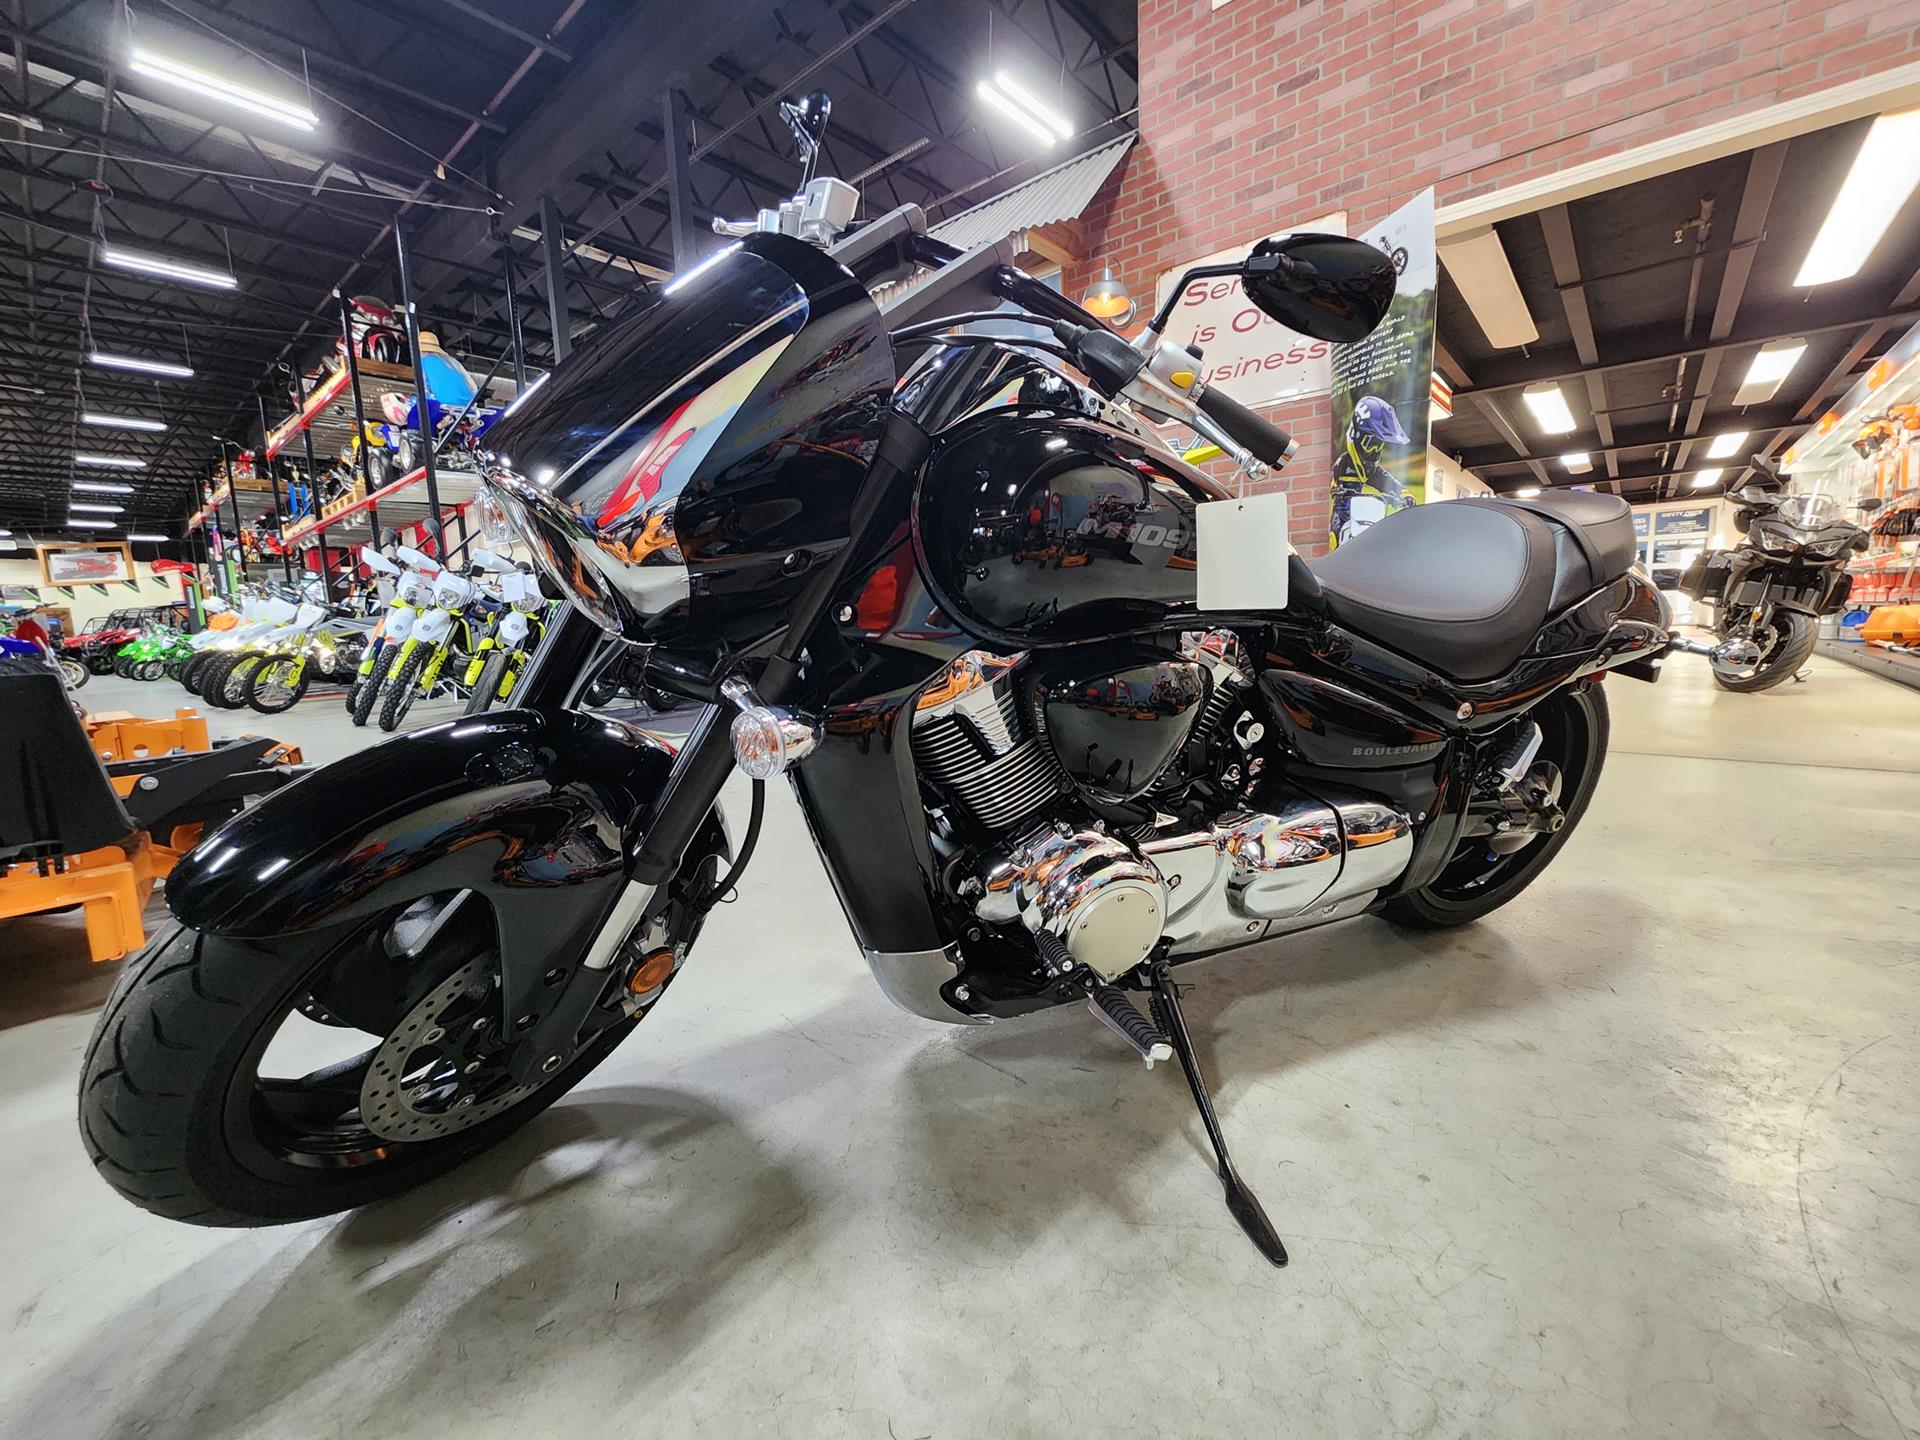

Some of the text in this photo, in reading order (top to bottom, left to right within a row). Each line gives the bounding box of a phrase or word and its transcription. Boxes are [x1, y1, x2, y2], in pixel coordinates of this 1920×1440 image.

[1184, 275, 1242, 306] Ser
[1191, 324, 1216, 346] is
[1384, 336, 1394, 344] THE
[1396, 331, 1415, 341] SAME
[1205, 341, 1328, 384] usiness
[1385, 360, 1398, 368] AND
[1352, 743, 1438, 756] BOULEVARD
